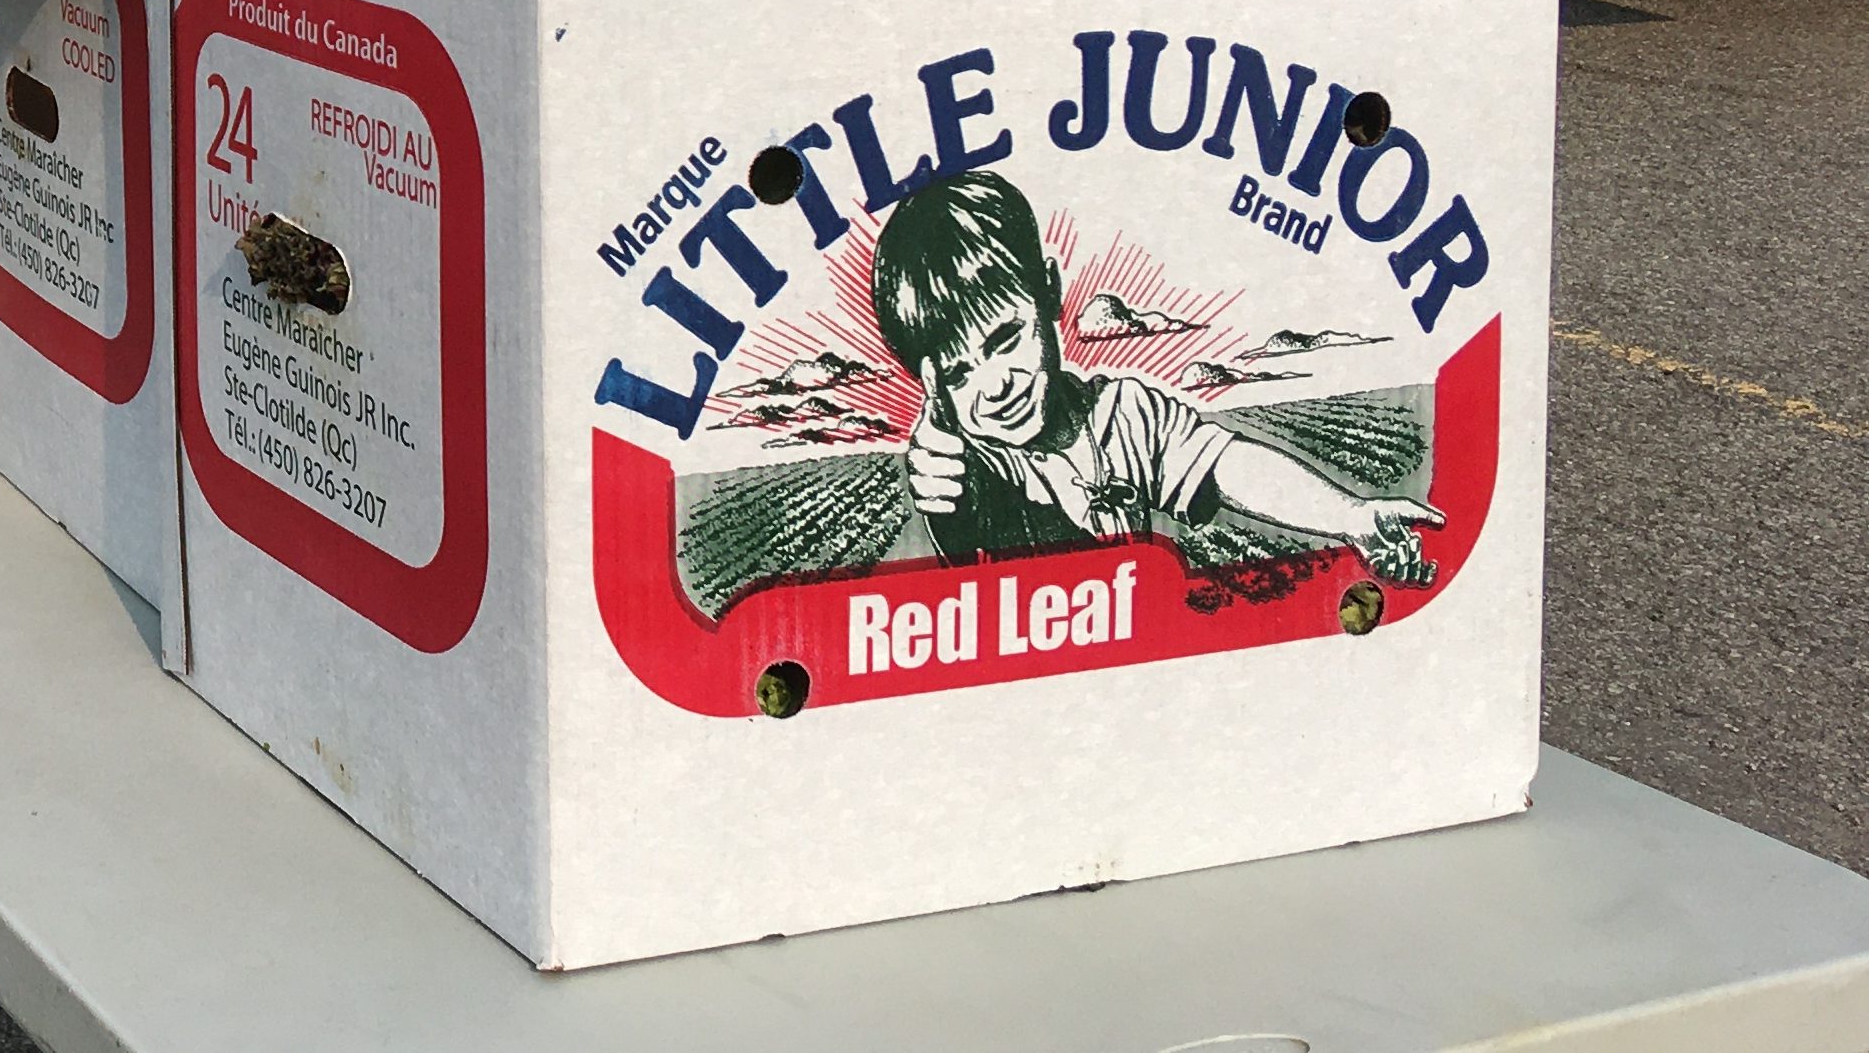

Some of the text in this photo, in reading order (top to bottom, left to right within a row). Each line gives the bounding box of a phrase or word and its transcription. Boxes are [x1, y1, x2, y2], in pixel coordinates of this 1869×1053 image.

[61, 37, 116, 84] COOLED
[294, 9, 319, 45] du
[322, 19, 398, 70] Canada
[26, 134, 84, 191] Maraîcher
[205, 72, 258, 184] 24
[310, 97, 433, 173] REFROIDI AU
[32, 172, 76, 225] Guinois
[77, 206, 92, 235] JR
[363, 147, 438, 211] Vacuum
[595, 131, 730, 279] Marque
[1228, 173, 1334, 256] Brand
[56, 225, 81, 268] (Qc)
[592, 28, 1491, 441] LITTLE JUNIOR
[44, 251, 100, 311] 826-3207
[222, 275, 363, 375] Centre Maraîcher
[222, 320, 417, 451] Eugène Guinois JR Inc.
[223, 364, 358, 471] Ste-Clotilde (Qc)
[303, 452, 388, 530] 826-3207
[846, 561, 1139, 677] Red Leaf
